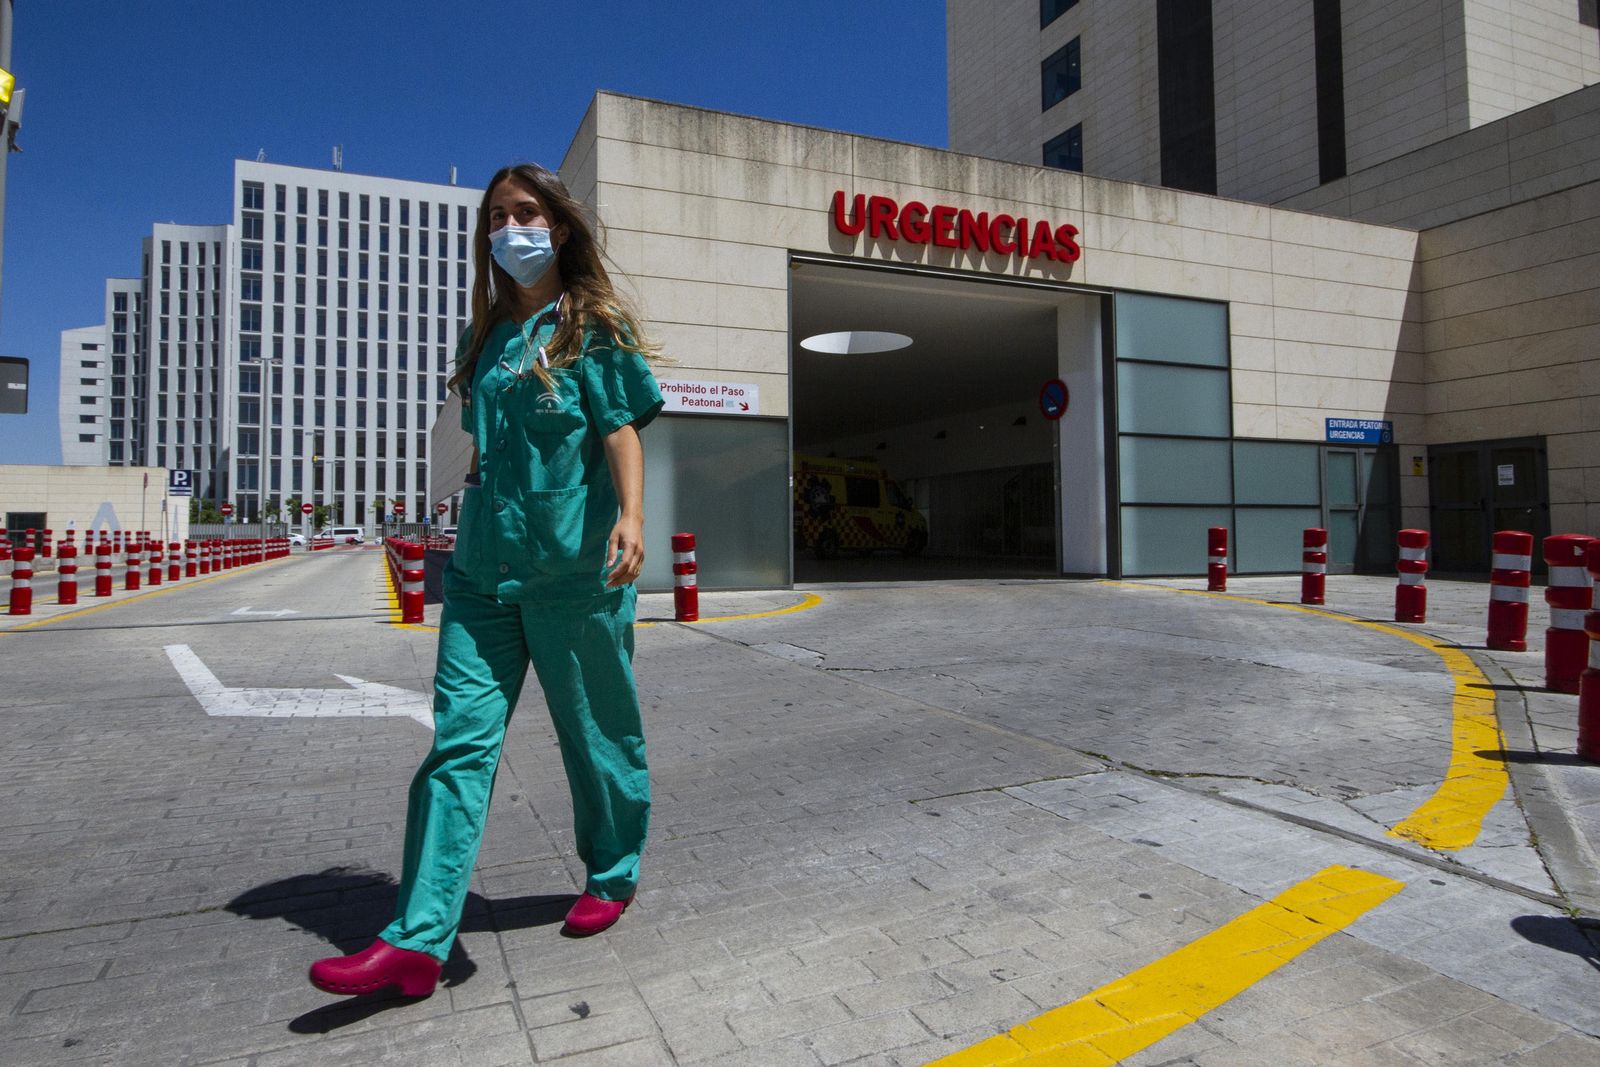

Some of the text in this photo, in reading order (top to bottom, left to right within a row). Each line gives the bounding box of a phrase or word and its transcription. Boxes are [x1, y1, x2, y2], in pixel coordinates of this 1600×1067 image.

[833, 190, 1081, 263] URGENCIAS
[660, 382, 744, 396] Prohibido el Paso
[681, 396, 724, 408] Peatonal
[1329, 420, 1358, 428] ENTRADA
[1329, 430, 1365, 439] URGENCIAS
